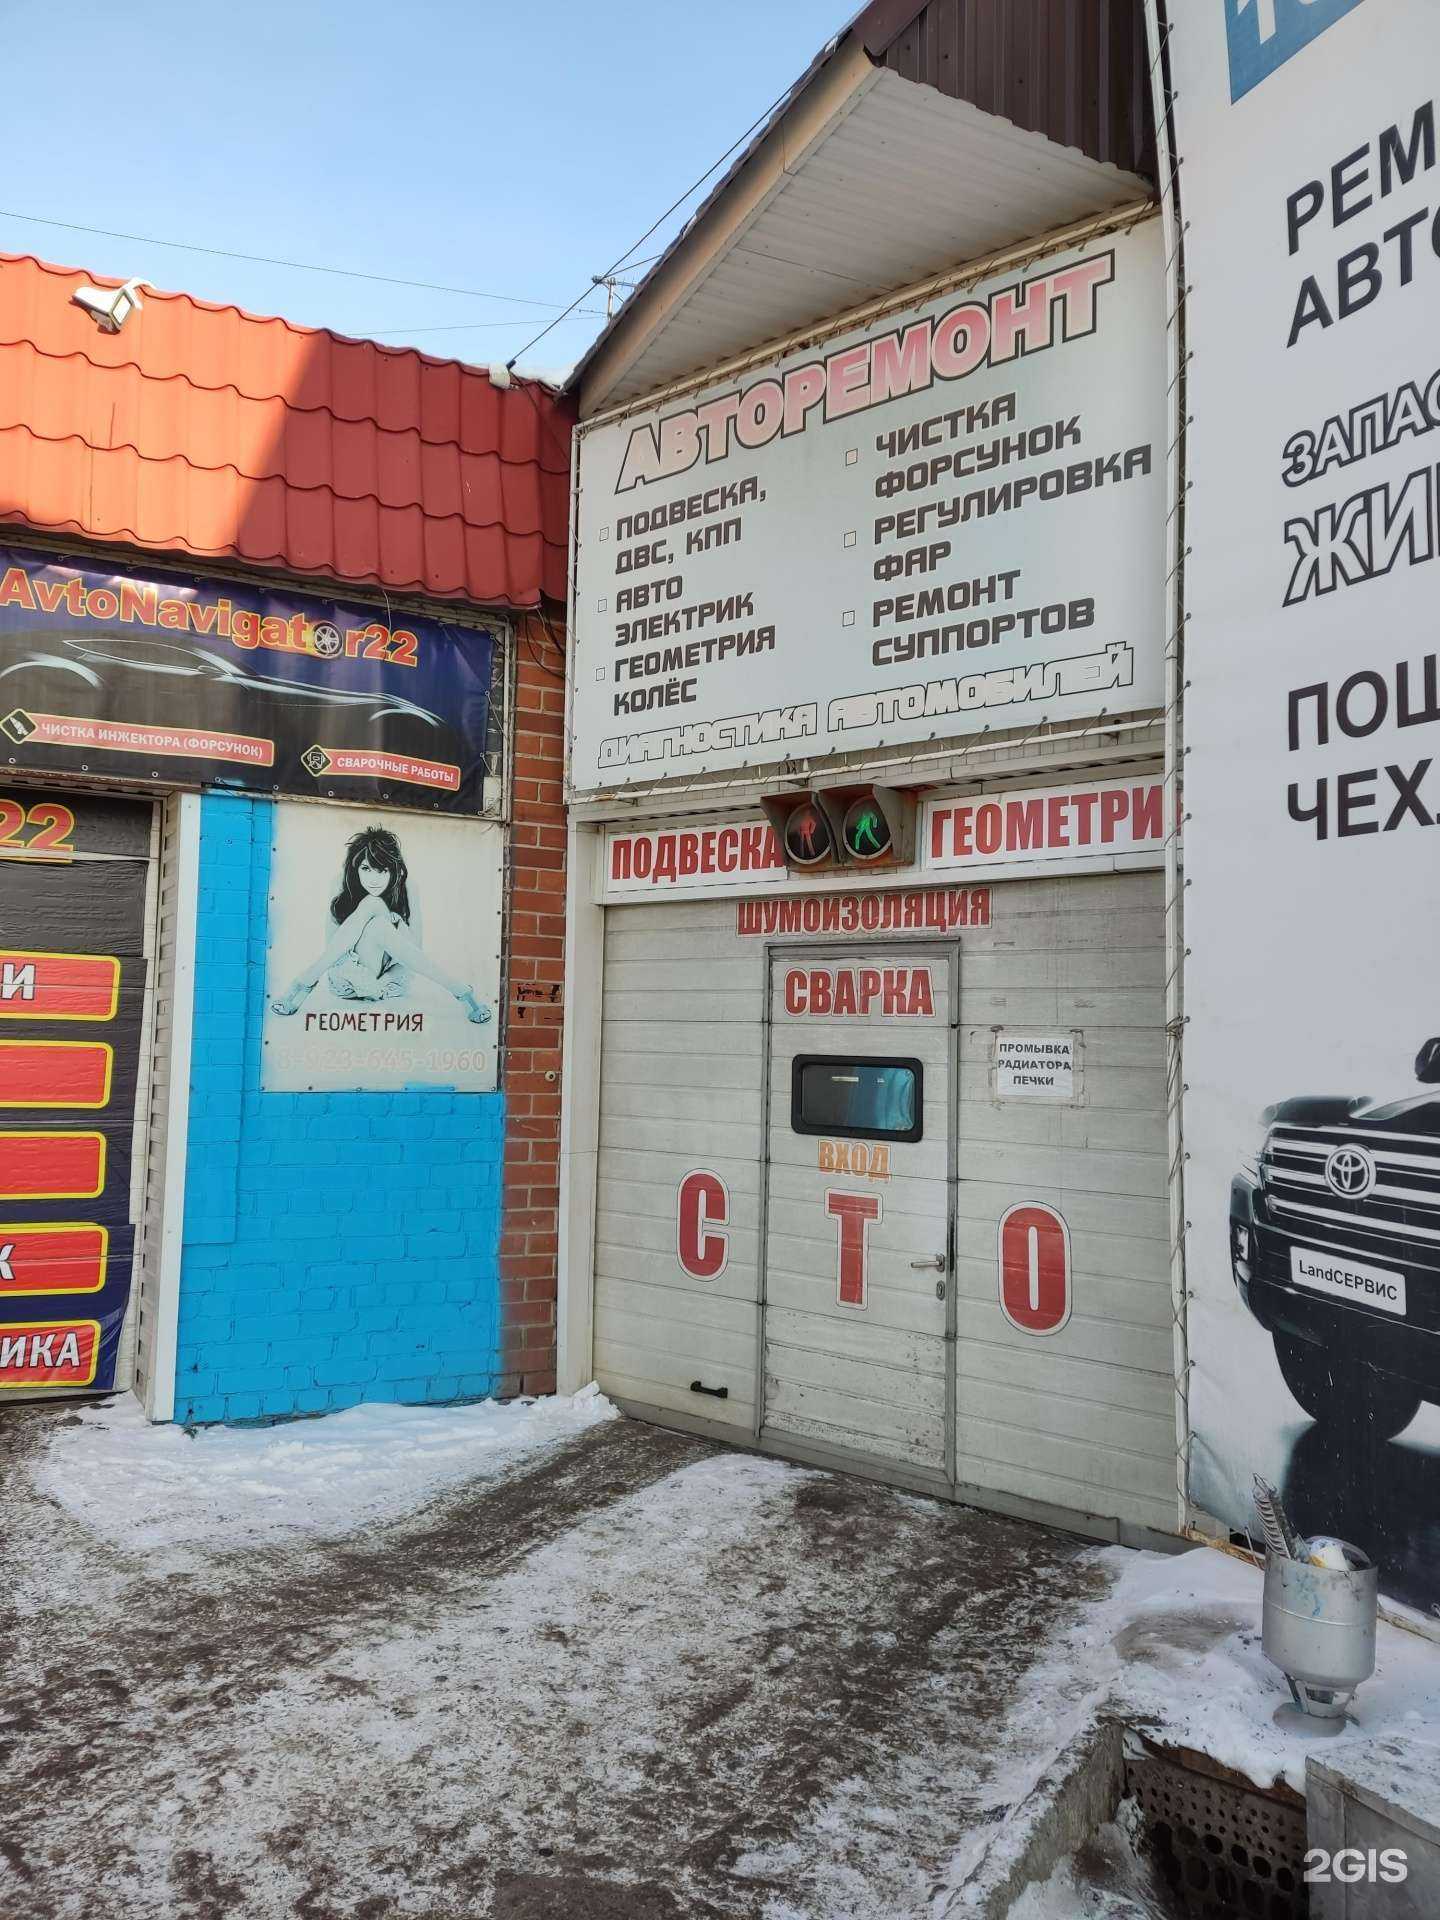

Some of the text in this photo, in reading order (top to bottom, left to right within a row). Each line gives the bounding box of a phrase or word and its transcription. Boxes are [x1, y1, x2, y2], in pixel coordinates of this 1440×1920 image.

[1286, 206, 1440, 349] АВТ
[615, 248, 1115, 494] АВТОРЕМОНТ
[875, 392, 1017, 459] ЧИСТКА
[874, 415, 1082, 499] ФОРСУНОК
[616, 476, 767, 540] ПОДВЕСКА,
[873, 443, 1153, 545] РЕГУЛИРОВКА
[614, 517, 743, 575] ДВС, КПП
[873, 541, 952, 581] ФАР
[1282, 462, 1440, 608] ЖИ
[614, 592, 754, 647] ЭЛЕКТРИК
[615, 575, 684, 613] АВТО
[871, 569, 1021, 628] РЕМОНТ
[614, 625, 776, 682] ГЕОМЕТРИЯ
[871, 598, 1096, 667] СУППОРТОВ
[597, 640, 1134, 769] ДИАГНОСТИКА АВТОМОБИЛЕЙ
[613, 678, 698, 717] КОЛЁС
[41, 721, 264, 760] ЧИСТКА ИНЖЕКТОРА (ФОРСУНОК)
[336, 755, 455, 783] СВАРОЧНЫЕ РАБОТЫ
[930, 784, 1183, 858] ГЕОМЕТРИ
[1287, 758, 1440, 841] ЧЕХ
[611, 825, 785, 884] ПОДВЕСКА
[736, 888, 992, 936] ШУМОИЗОЛЯЦИЯ
[784, 967, 935, 1017] СВАРКА
[304, 1012, 424, 1032] ГЕОМЕТРИЯ
[999, 1043, 1070, 1055] ПРОМЫВКА
[998, 1059, 1072, 1071] РАДИАТОРА
[1013, 1075, 1055, 1086] ПЕЧКИ
[818, 1139, 892, 1182] ВХОД
[1299, 1258, 1398, 1301] LandСЕРВИС
